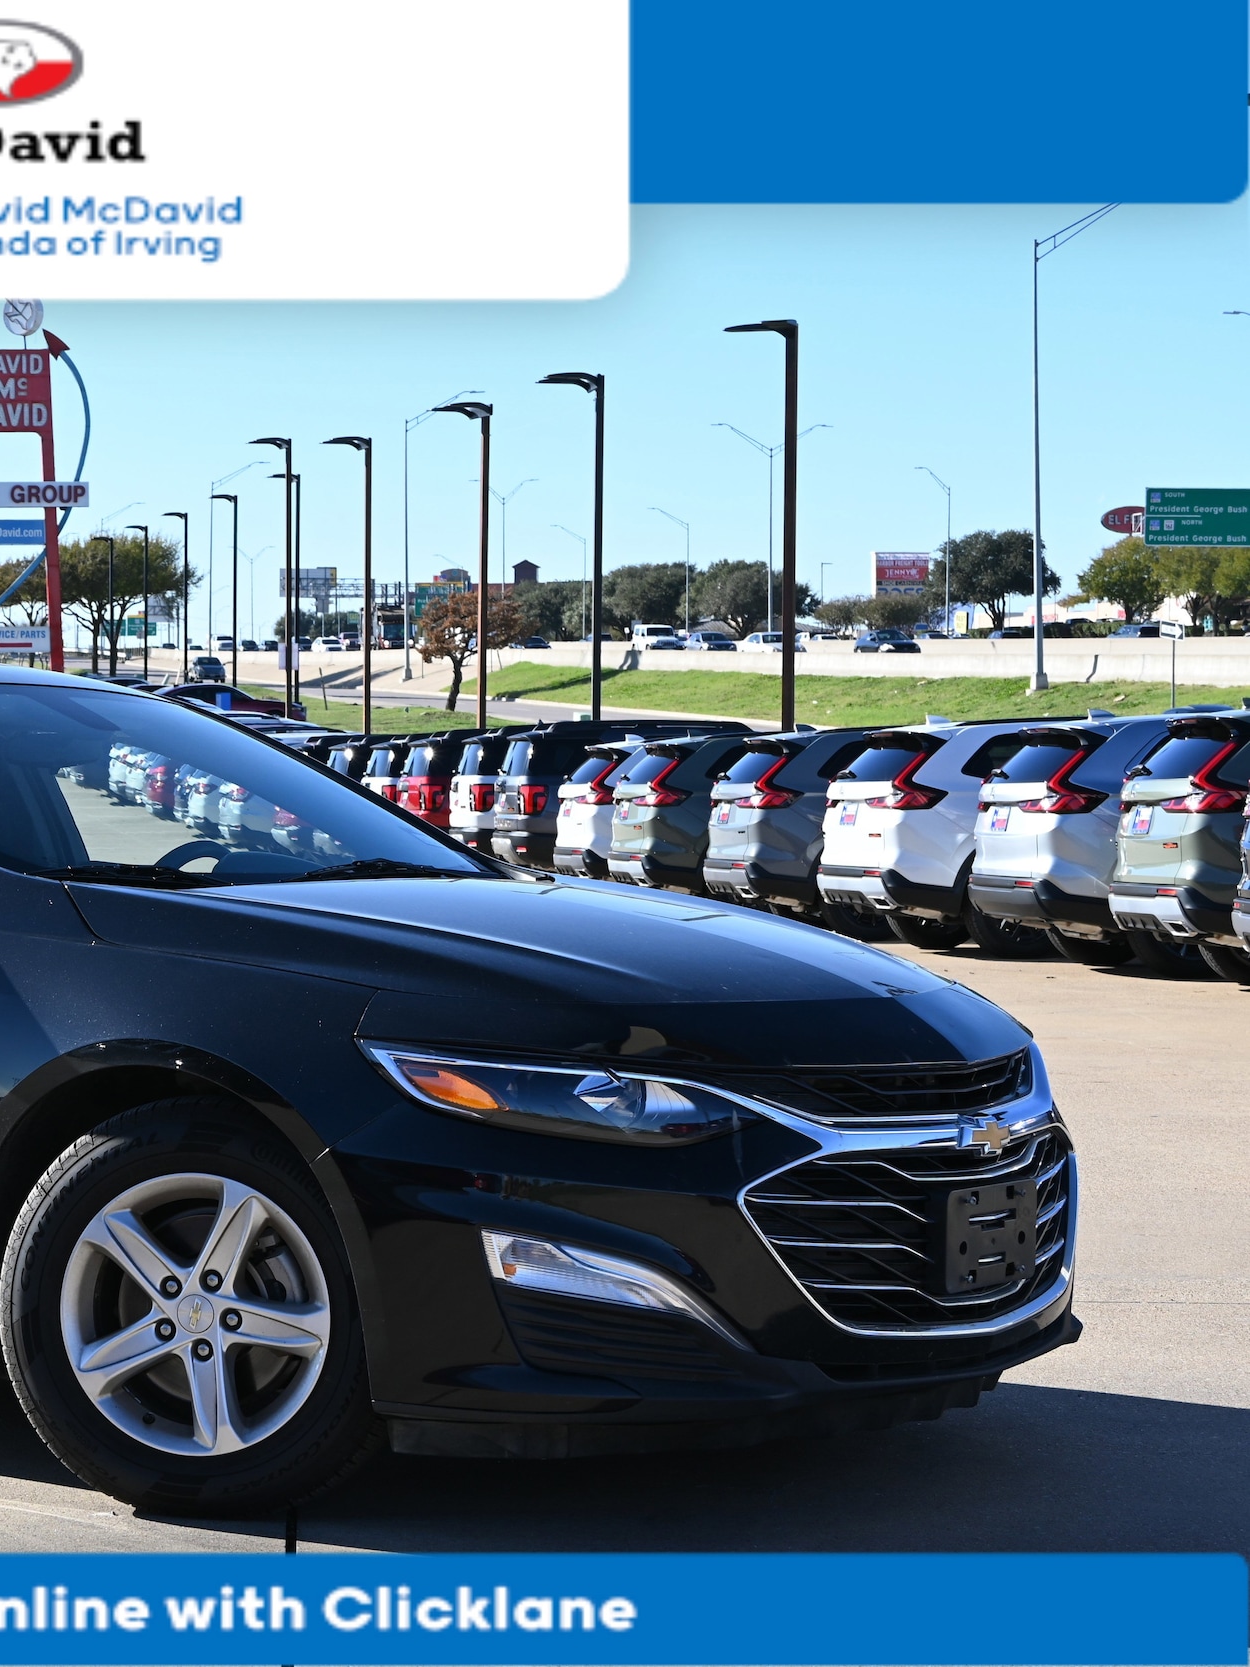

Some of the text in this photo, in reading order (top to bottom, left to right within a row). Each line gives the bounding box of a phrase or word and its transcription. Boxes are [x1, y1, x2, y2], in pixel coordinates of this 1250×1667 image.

[10, 484, 86, 503] GROUP
[1150, 505, 1190, 513] President
[1193, 505, 1224, 515] George
[1108, 514, 1121, 525] EL
[1148, 534, 1247, 543] President George Bush
[885, 568, 911, 578] JENNY
[21, 1131, 163, 1292] CONTINENTAL
